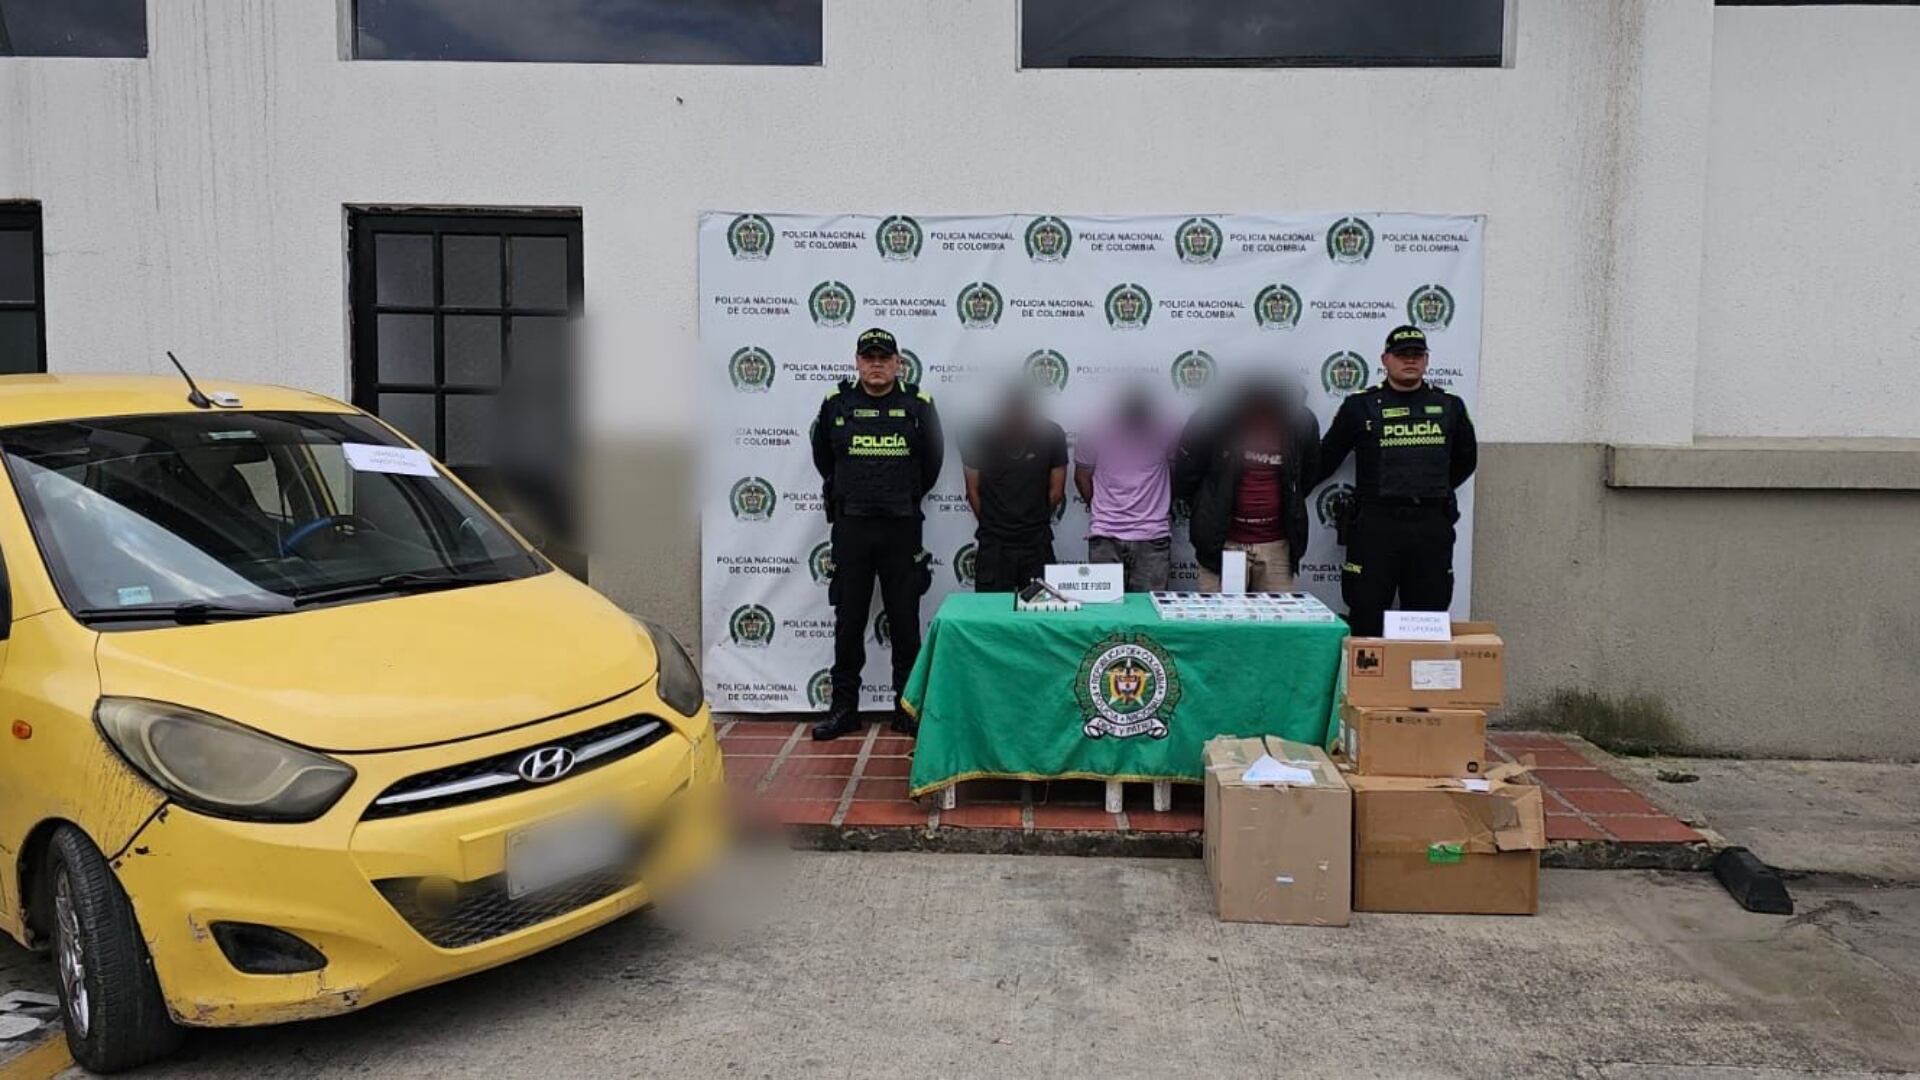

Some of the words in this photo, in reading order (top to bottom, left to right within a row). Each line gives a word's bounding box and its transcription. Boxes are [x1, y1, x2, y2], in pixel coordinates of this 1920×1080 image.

[782, 230, 818, 239] POLICIA
[820, 231, 866, 240] NACIONAL
[930, 232, 966, 240] POLICIA
[968, 232, 1015, 241] NACIONAL
[1079, 233, 1115, 241] POLICIA
[1118, 233, 1164, 241] NACIONAL
[1230, 233, 1266, 241] POLICIA
[1269, 234, 1316, 242] NACIONAL
[1382, 233, 1419, 242] POLICIA
[1421, 234, 1469, 242] NACIONAL
[794, 240, 806, 249] DE
[809, 241, 858, 250] COLOMBIA
[942, 242, 955, 250] DE
[957, 242, 1005, 250] COLOMBIA
[1091, 243, 1103, 251] DE
[1106, 243, 1155, 251] COLOMBIA
[1242, 243, 1254, 251] DE
[1257, 243, 1306, 252] COLOMBIA
[1395, 243, 1407, 251] DE
[1410, 244, 1460, 252] COLOMBIA
[715, 296, 751, 304] POLICIA
[752, 296, 799, 305] NACIONAL
[900, 299, 947, 307] NACIONAL
[1010, 300, 1046, 308] POLICIA
[1048, 300, 1094, 308] NACIONAL
[1159, 300, 1196, 308] POLICIA
[1198, 300, 1245, 309] NACIONAL
[1310, 301, 1346, 309] POLICIA
[1349, 301, 1397, 310] NACIONAL
[727, 306, 739, 314] DE
[742, 306, 790, 315] COLOMBIA
[875, 308, 887, 316] DE
[890, 308, 937, 317] COLOMBIA
[1021, 309, 1033, 317] DE
[1036, 309, 1085, 318] COLOMBIA
[1171, 310, 1183, 318] DE
[1186, 310, 1235, 319] COLOMBIA
[1322, 311, 1334, 319] DE
[1337, 311, 1386, 319] COLOMBIA
[783, 363, 818, 371] POLICIA
[821, 363, 858, 372] NACIONA
[795, 373, 807, 381] DE
[754, 428, 800, 436] NACIONAL
[1383, 420, 1442, 436] POLICÍA
[743, 437, 791, 446] COLOMBIA
[853, 433, 906, 447] POLICÍA
[783, 492, 818, 501] POLICIA
[928, 494, 963, 502] POLICIA
[795, 503, 807, 511] DE
[939, 504, 952, 512] DE
[716, 556, 752, 564] POLICIA
[754, 556, 800, 565] NACIONAL
[729, 566, 741, 574] DE
[743, 566, 791, 574] COLOMBIA
[1301, 564, 1336, 572] POLICIA
[1312, 574, 1325, 582] DE
[783, 620, 818, 628] POLICIA
[716, 683, 751, 691] POLICIA
[753, 684, 798, 692] NACIONAL
[728, 693, 740, 701] DE
[743, 693, 789, 702] COLOMBIA
[872, 694, 885, 702] DE
